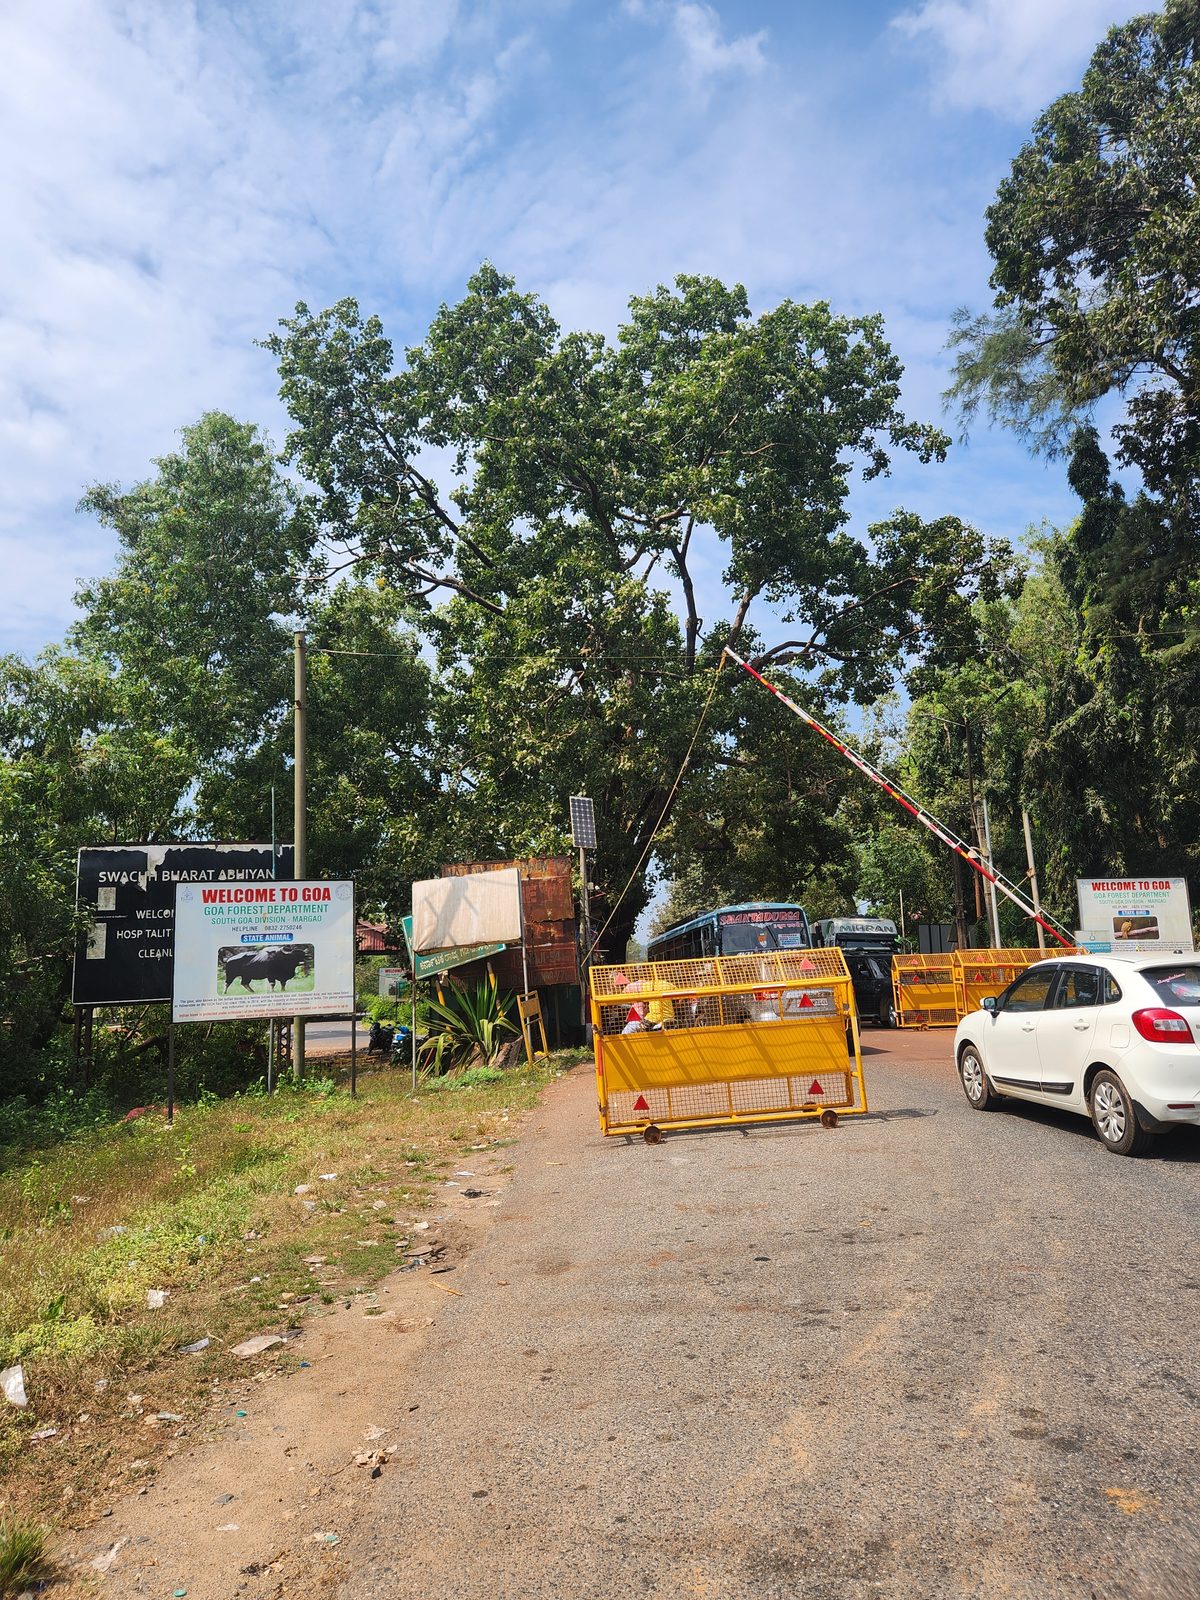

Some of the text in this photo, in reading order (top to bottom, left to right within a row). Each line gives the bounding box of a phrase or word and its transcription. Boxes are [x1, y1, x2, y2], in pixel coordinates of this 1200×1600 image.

[162, 870, 215, 881] BHARAT
[218, 869, 274, 880] ABHIYAN
[1091, 881, 1171, 891] WELCOME TO GOA
[202, 887, 331, 904] WELCOME TO GOA
[135, 909, 174, 919] WELCO
[204, 904, 329, 916] GOA FOREST DEPARTMENT
[211, 917, 236, 925] SOUTH
[238, 916, 253, 924] GOA
[255, 916, 286, 924] DIVISION
[292, 915, 322, 923] MARGAO
[243, 934, 265, 942] STATE
